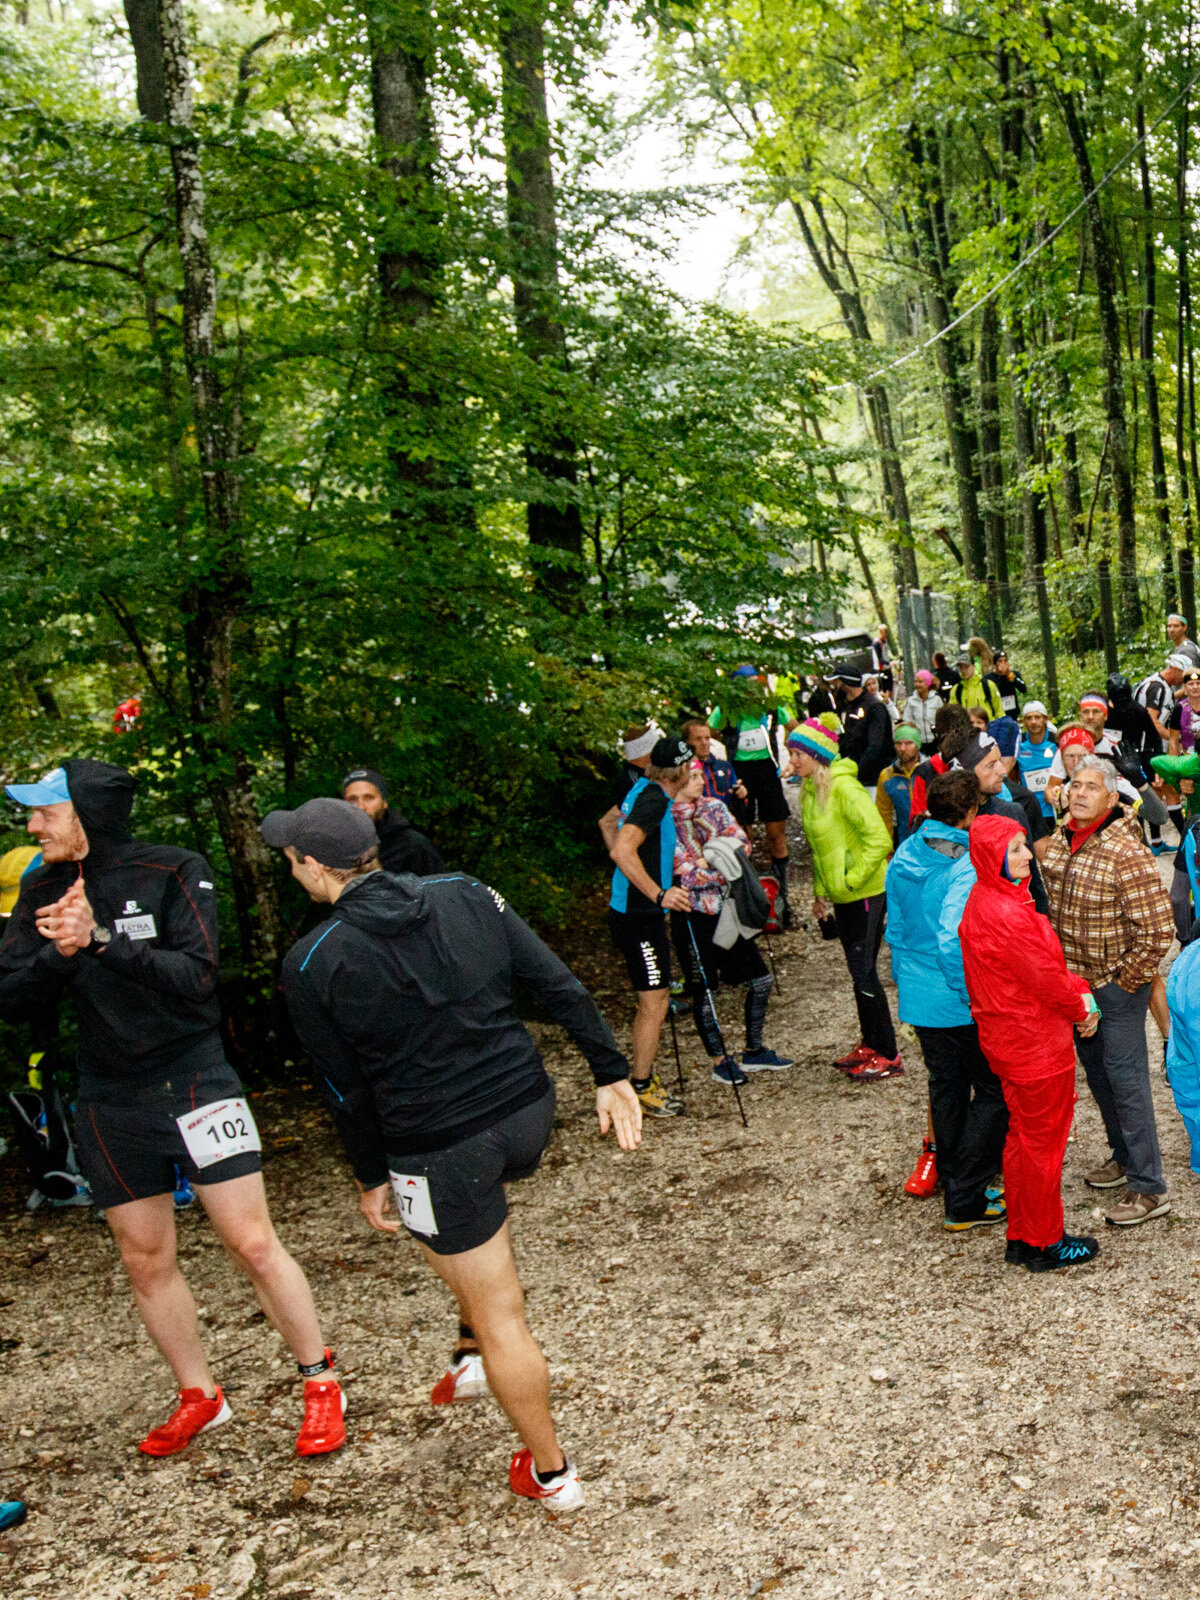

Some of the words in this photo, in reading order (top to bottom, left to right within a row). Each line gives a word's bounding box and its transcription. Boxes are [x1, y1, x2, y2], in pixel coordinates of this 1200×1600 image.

[744, 737, 756, 747] 21
[1035, 776, 1047, 785] 60
[640, 940, 661, 986] skinfit
[207, 1118, 249, 1143] 102
